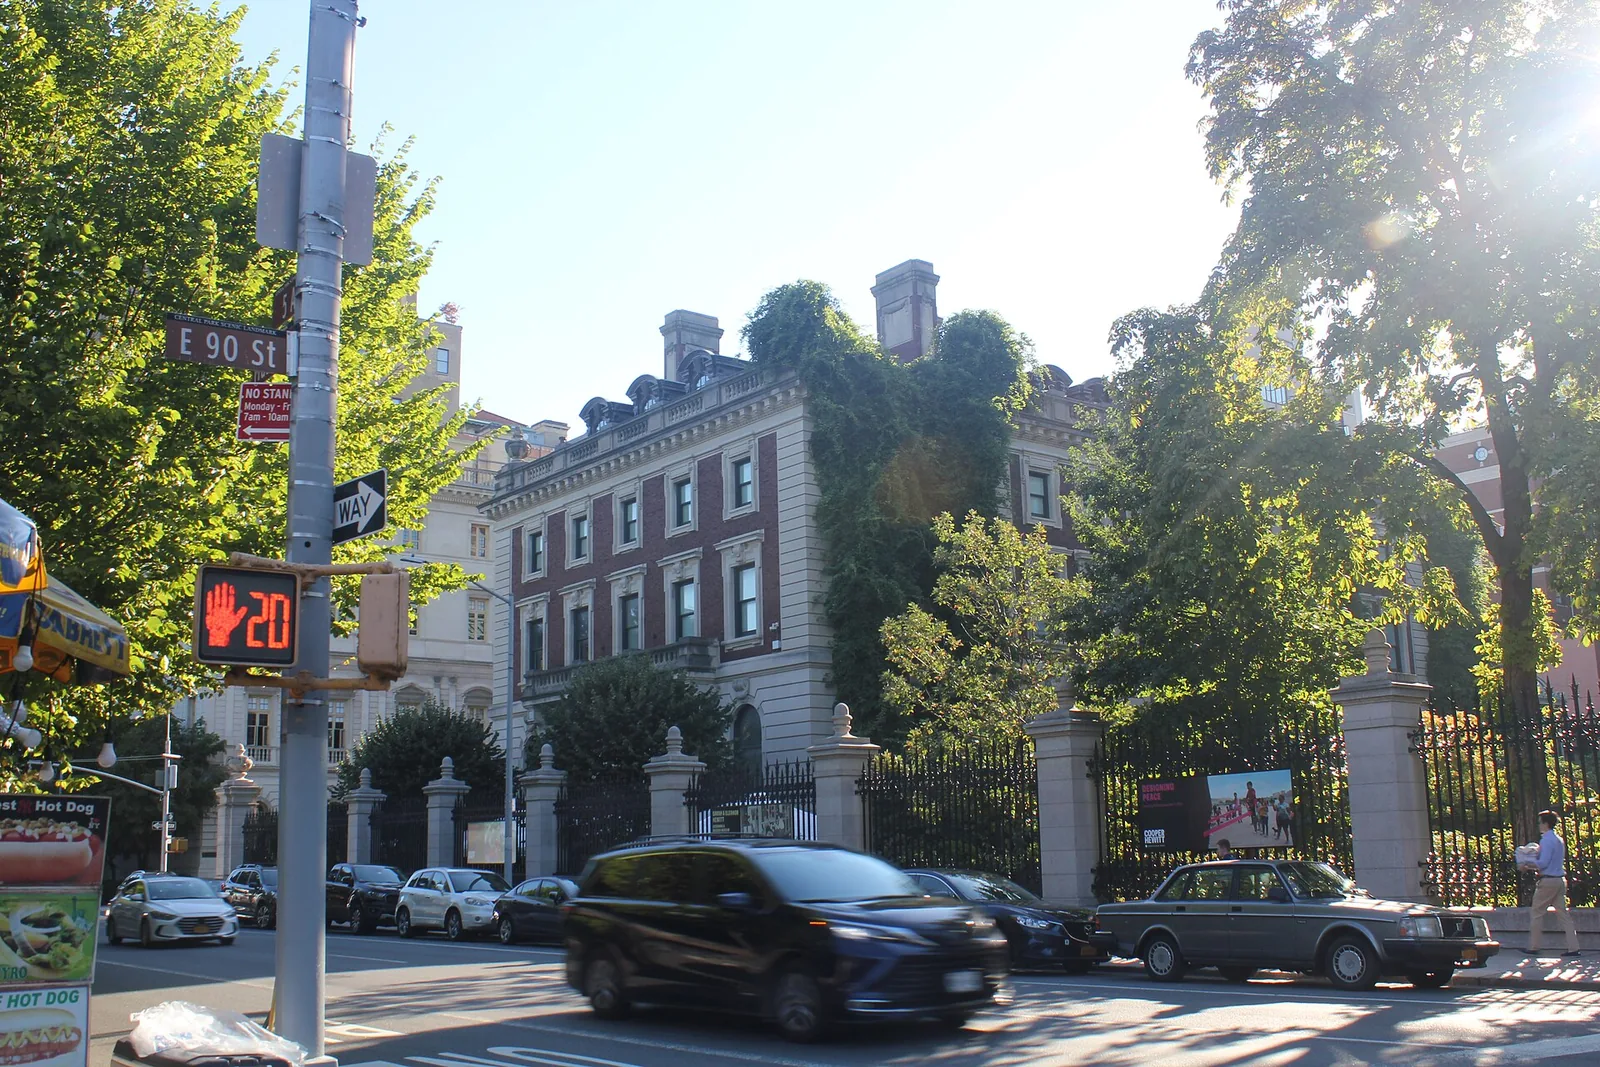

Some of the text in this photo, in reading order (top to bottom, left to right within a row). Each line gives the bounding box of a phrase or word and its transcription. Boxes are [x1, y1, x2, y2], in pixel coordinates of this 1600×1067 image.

[174, 314, 277, 336] CENTRAL PARK SCENIC LANDMARK
[180, 328, 276, 368] E 90 St
[246, 388, 260, 398] NO
[244, 402, 275, 412] Monday
[244, 412, 260, 421] 7am
[268, 412, 288, 422] 10am
[339, 492, 371, 524] WAY
[246, 591, 290, 649] 20
[1143, 793, 1160, 802] PEACE
[36, 800, 62, 812] Hot
[66, 802, 94, 815] Dog
[1144, 830, 1164, 838] COOPER
[7, 992, 42, 1008] HOT
[46, 990, 80, 1005] DOG
